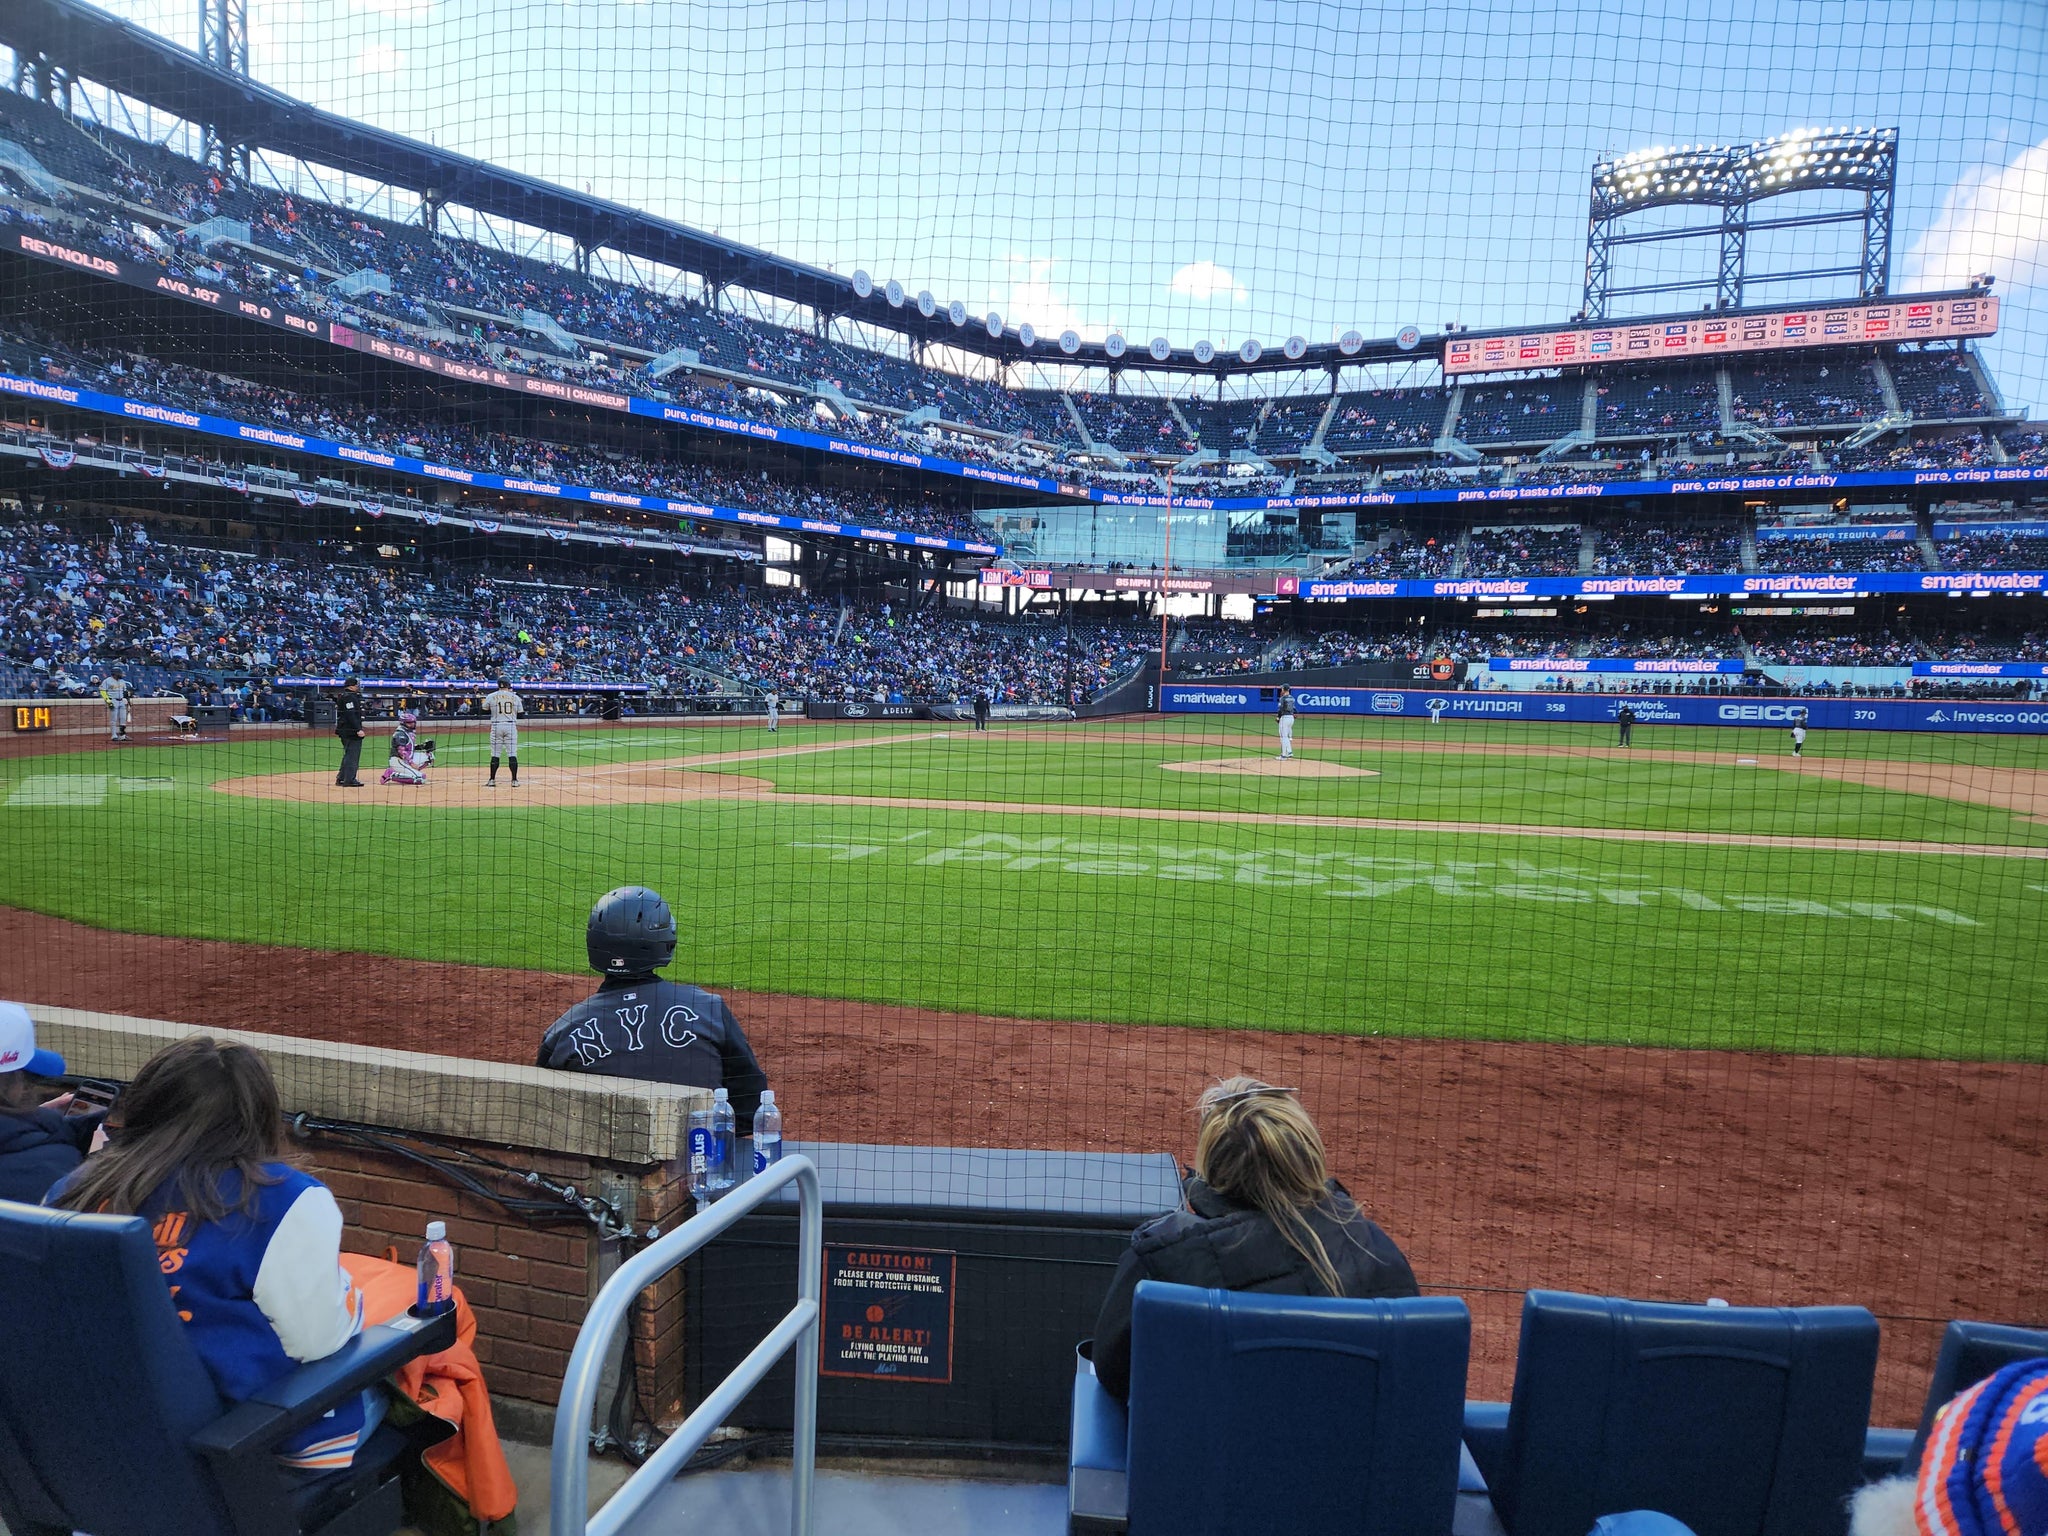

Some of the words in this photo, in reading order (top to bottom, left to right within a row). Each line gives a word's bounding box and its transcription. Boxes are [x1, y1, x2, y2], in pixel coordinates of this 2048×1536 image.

[20, 235, 121, 276] REYNOLDS
[157, 277, 190, 297] AVG
[190, 288, 221, 304] .167
[859, 277, 866, 290] 5
[891, 287, 900, 300] 18
[239, 301, 258, 315] HR
[923, 297, 931, 310] 16
[952, 307, 963, 320] 24
[285, 314, 306, 328] RBI
[1065, 337, 1076, 348] 31
[1341, 338, 1362, 348] SHEA
[1401, 332, 1416, 343] 42
[1110, 340, 1121, 352] 41
[1155, 343, 1166, 354] 14
[1198, 346, 1211, 357] 37
[371, 339, 391, 355] HB:
[392, 346, 415, 362] 17.6
[419, 354, 433, 368] IN.
[494, 373, 510, 386] IN.
[526, 379, 541, 391] 85
[541, 382, 565, 396] MPH
[572, 389, 626, 408] CHANGEUP
[0, 375, 79, 403] martwater
[124, 401, 201, 427] smartwater
[664, 407, 690, 422] pure,
[690, 412, 715, 427] crisp
[715, 416, 739, 430] taste
[739, 420, 751, 433] of
[750, 423, 778, 439] clarity
[240, 426, 306, 449] smartwater
[338, 446, 396, 467] smartwater
[829, 440, 851, 453] pure,
[850, 444, 871, 457] crisp
[870, 447, 889, 458] taste
[889, 451, 899, 461] of
[898, 453, 922, 467] clarity
[423, 464, 474, 482] smartwater
[1915, 471, 1952, 484] pure,
[1954, 470, 1991, 483] crisp
[1993, 469, 2031, 480] taste
[503, 479, 561, 495] smartwater
[1672, 481, 1705, 493] pure,
[1706, 479, 1740, 491] crisp
[1742, 477, 1776, 489] taste
[1777, 476, 1793, 487] of
[1794, 475, 1838, 488] clarity
[589, 491, 642, 506] smartwater
[1458, 491, 1488, 502] pure,
[1489, 489, 1517, 501] crisp
[1519, 487, 1550, 498] taste
[1550, 485, 1565, 496] of
[1565, 484, 1604, 498] clarity
[1102, 493, 1121, 504] pure,
[1121, 494, 1147, 507] crisp
[1147, 496, 1172, 507] taste
[1172, 497, 1184, 507] of
[1184, 498, 1214, 509] clarity
[1267, 498, 1293, 509] pure,
[1294, 496, 1320, 508] crisp
[1321, 495, 1348, 505] taste
[1348, 494, 1361, 504] of
[1361, 493, 1396, 506] clarity
[667, 502, 716, 516] smartwater
[737, 511, 781, 525] smartwater
[1838, 530, 1877, 540] TEQUILA
[983, 572, 1002, 584] LGM
[1031, 573, 1050, 586] LGM
[1115, 578, 1129, 588] 85
[1129, 579, 1151, 588] MPH
[1744, 575, 1858, 592] smartwater
[1922, 573, 2043, 590] smartwater
[1283, 579, 1294, 593] 4
[1310, 582, 1397, 597] smartwater
[1434, 580, 1529, 596] smartwater
[1582, 577, 1686, 594] smartwater
[1439, 665, 1451, 674] 02
[1510, 659, 1590, 672] smartwater
[1634, 660, 1718, 673] smartwater
[1931, 663, 2003, 675] smartwater
[1172, 692, 1240, 706] smartwater
[1297, 694, 1351, 708] Canon
[1618, 700, 1668, 710] NewYork-
[498, 701, 513, 715] 10
[848, 706, 866, 715] Ford
[1453, 700, 1523, 713] HYUNDAI
[1546, 703, 1566, 713] 358
[1719, 704, 1809, 721] GEICO
[1854, 710, 1876, 721] 370
[1953, 710, 2015, 723] Invesco
[569, 1004, 699, 1066] NYC
[694, 1133, 707, 1174] smart
[847, 1252, 932, 1270] CAUTION!
[838, 1269, 864, 1279] PLEASE
[866, 1271, 884, 1280] KEEP
[885, 1272, 904, 1281] YOUR
[906, 1273, 940, 1284] DISTANCE
[833, 1278, 853, 1287] FROM
[855, 1279, 868, 1288] THE
[870, 1281, 911, 1291] PROTECTIVE
[913, 1284, 944, 1293] NETTING.
[842, 1324, 863, 1339] BE
[869, 1326, 931, 1345] ALERT!
[850, 1342, 874, 1352] FLYING
[876, 1343, 906, 1353] OBJECTS
[907, 1346, 923, 1355] MAY
[841, 1350, 862, 1359] LEAVE
[863, 1352, 877, 1360] THE
[878, 1353, 908, 1363] PLAYING
[910, 1355, 929, 1364] FIELD
